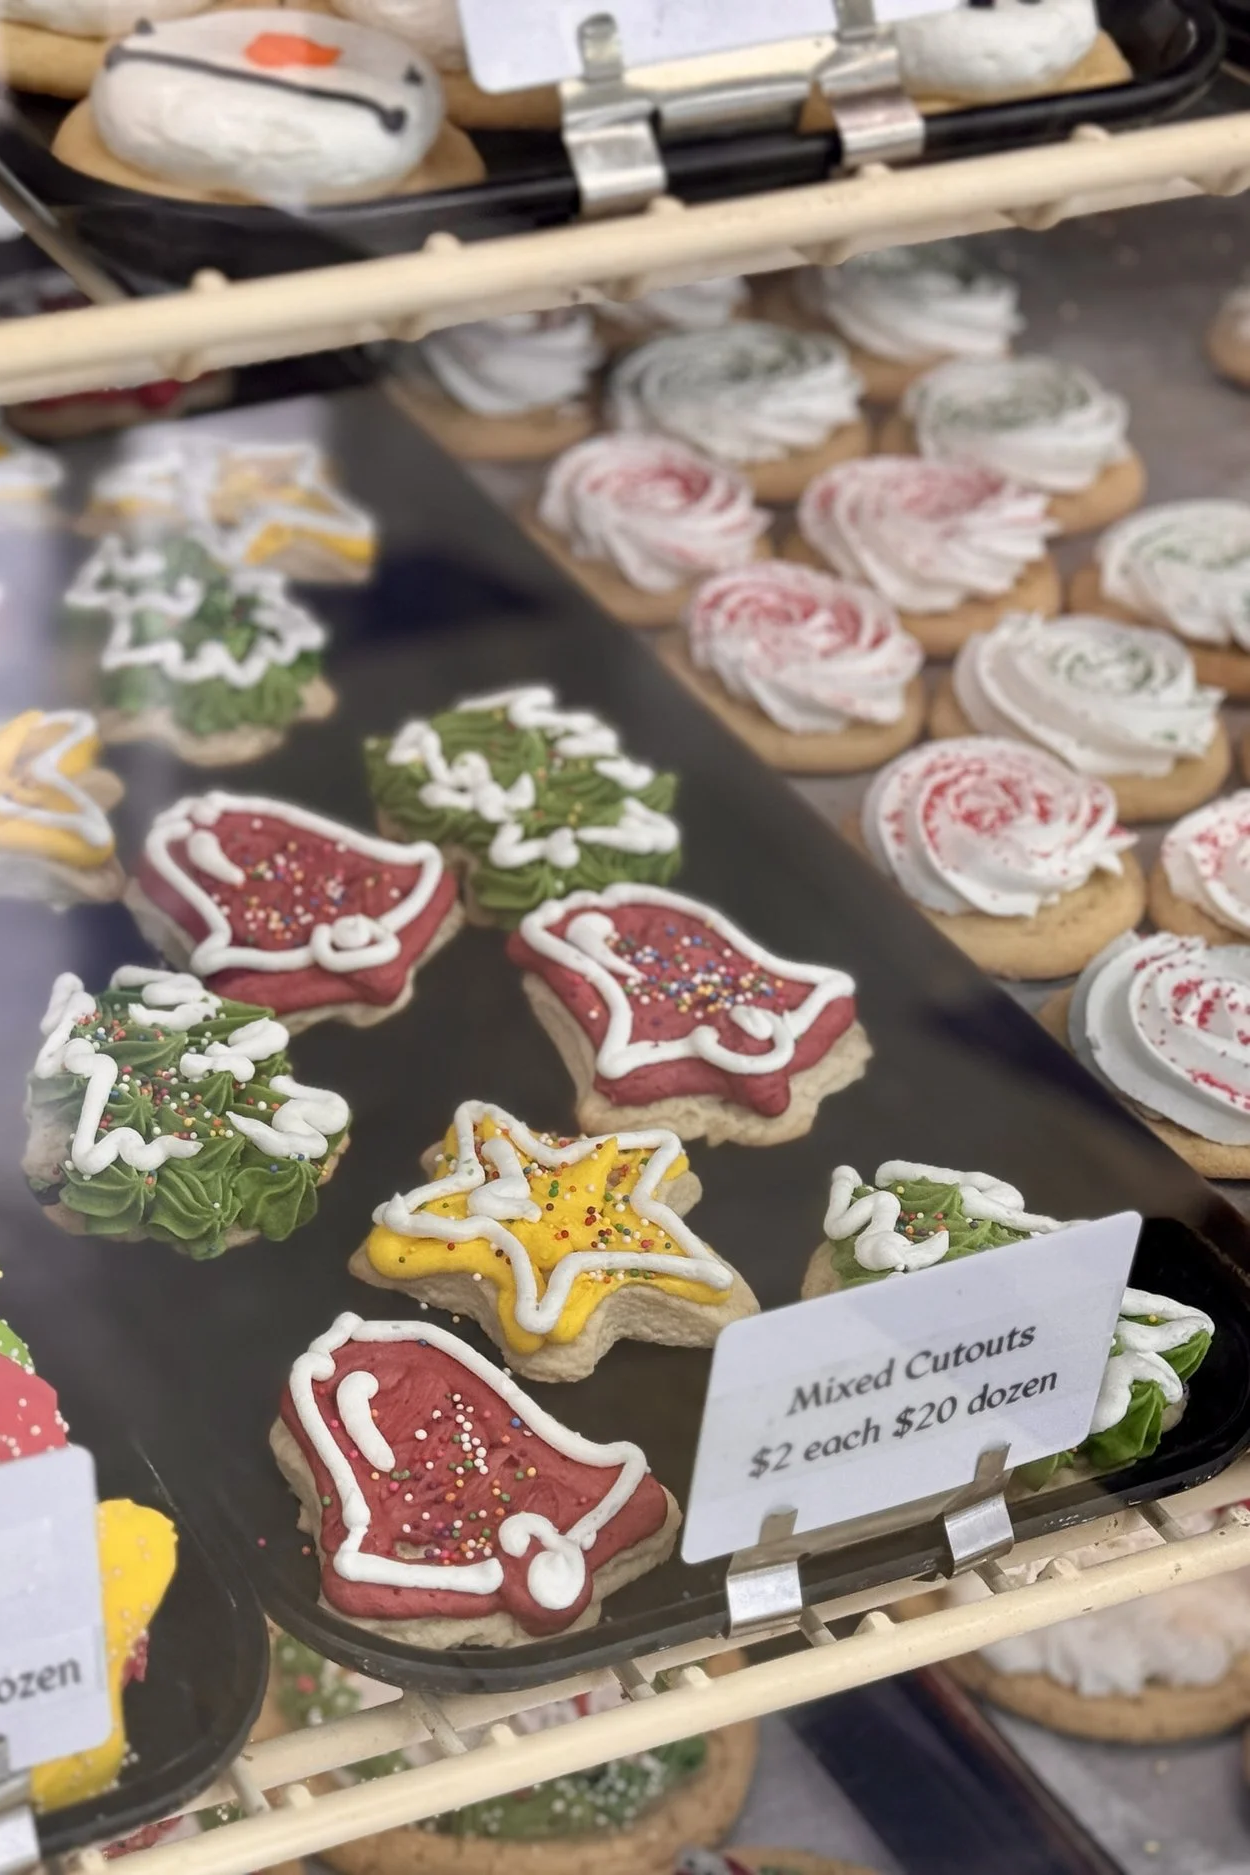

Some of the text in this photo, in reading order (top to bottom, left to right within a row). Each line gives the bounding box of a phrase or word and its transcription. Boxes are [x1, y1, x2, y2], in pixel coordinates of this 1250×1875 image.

[785, 1322, 1037, 1417] Mixed Cutouts
[748, 1371, 1058, 1480] $2 each $20 dozen
